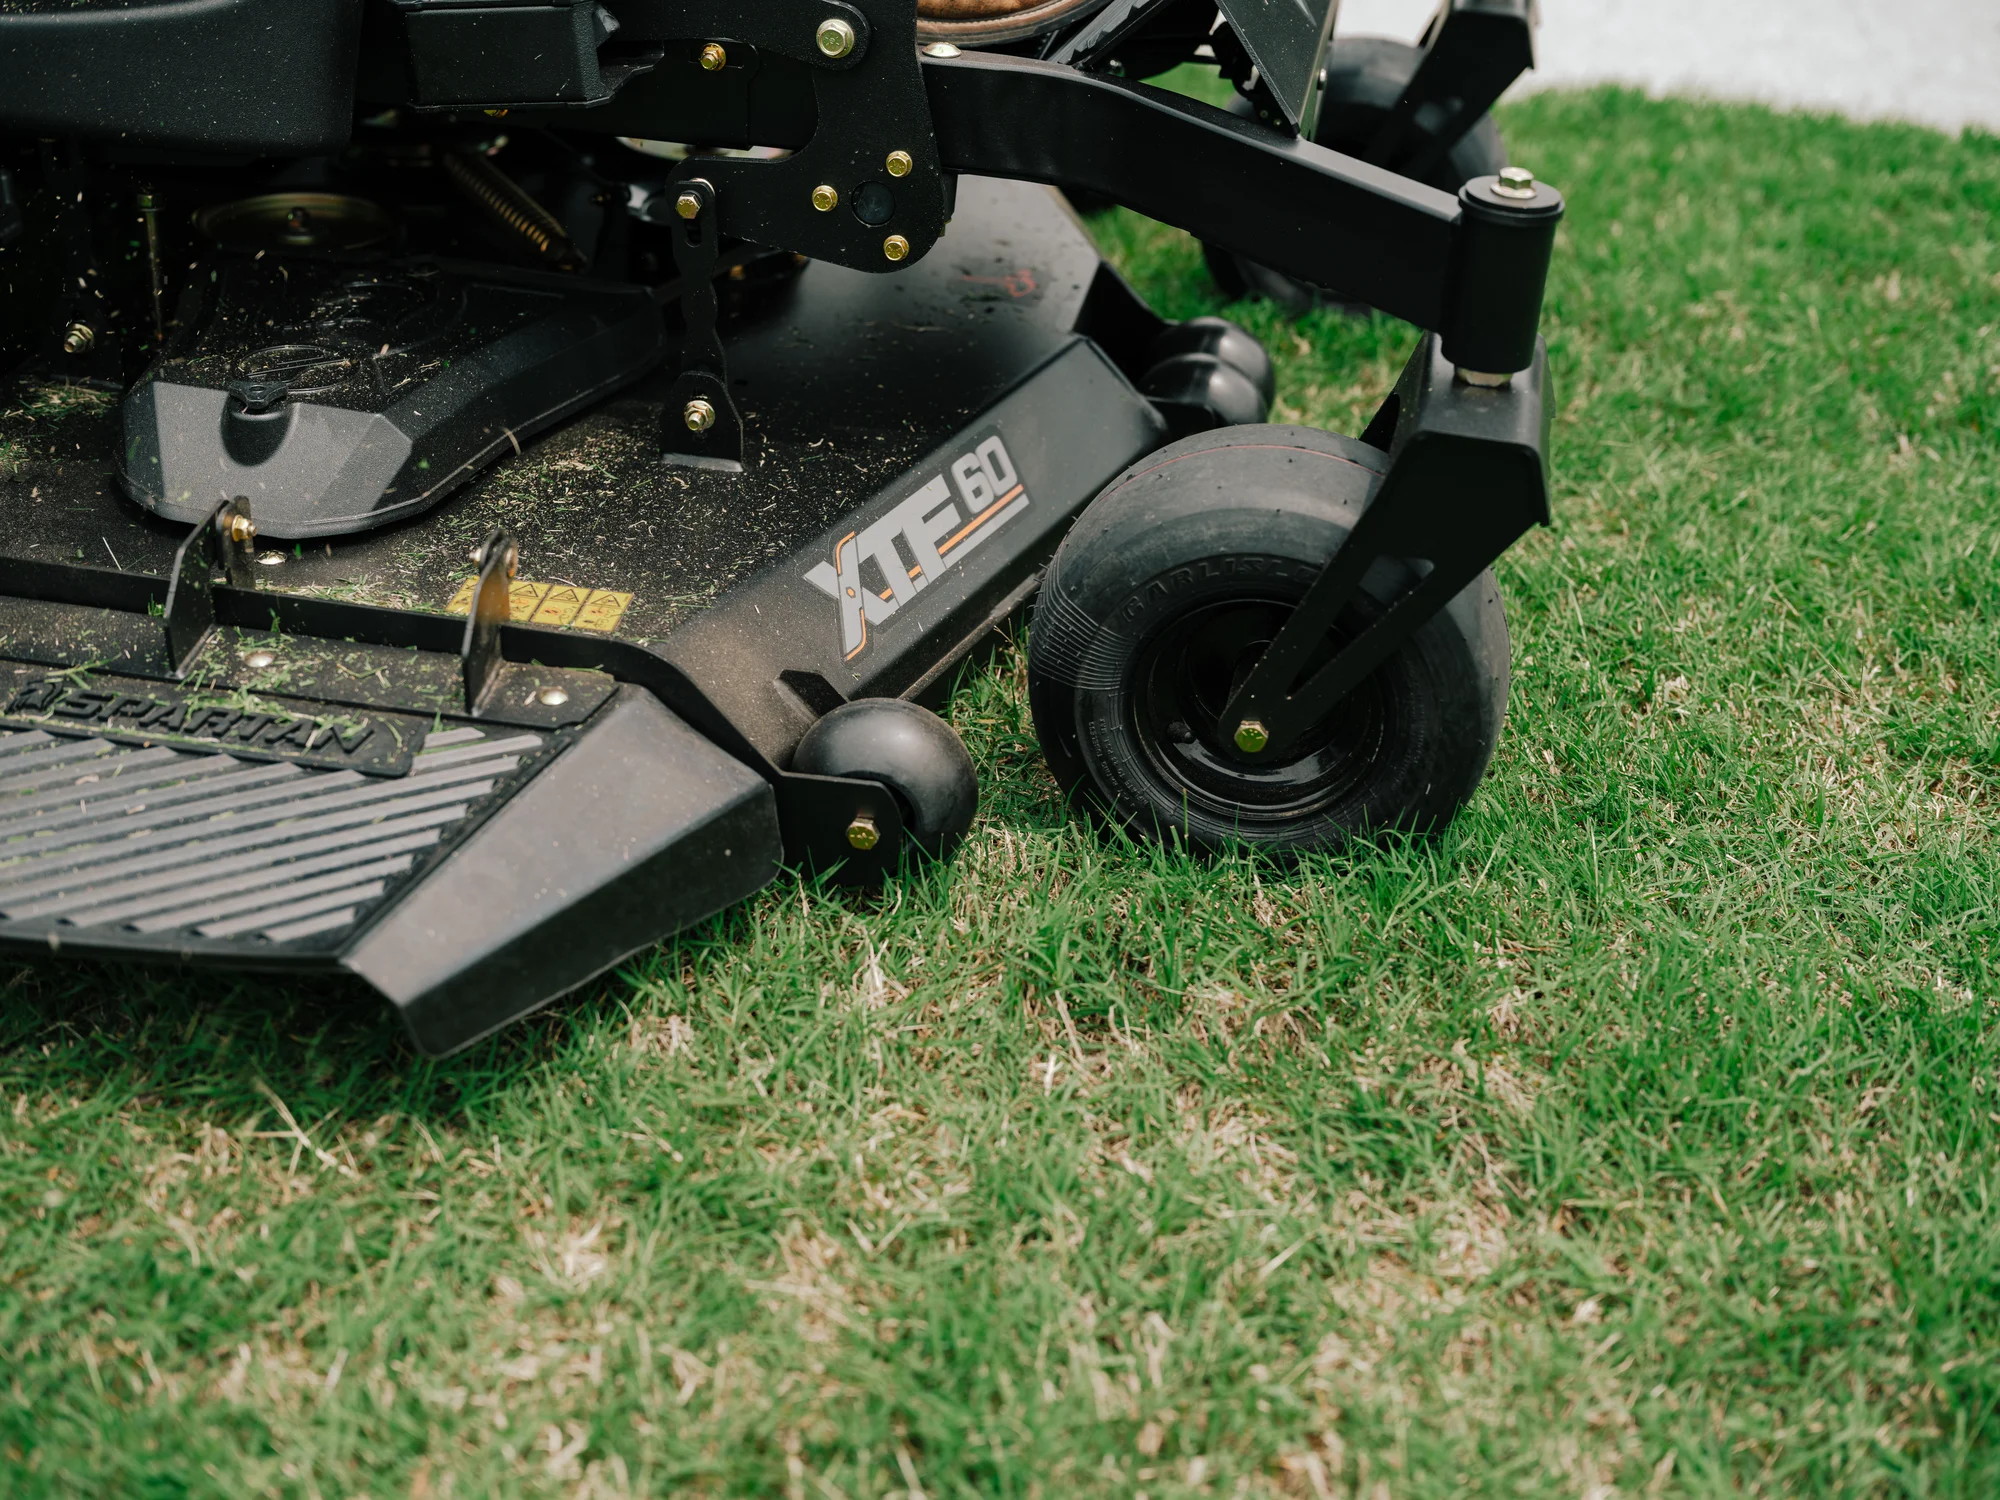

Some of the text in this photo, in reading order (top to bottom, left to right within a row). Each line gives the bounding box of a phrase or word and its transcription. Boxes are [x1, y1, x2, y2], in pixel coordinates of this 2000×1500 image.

[803, 435, 1018, 662] XTF 60
[1121, 558, 1320, 622] CARLISLE
[55, 689, 375, 754] SPARTAN
